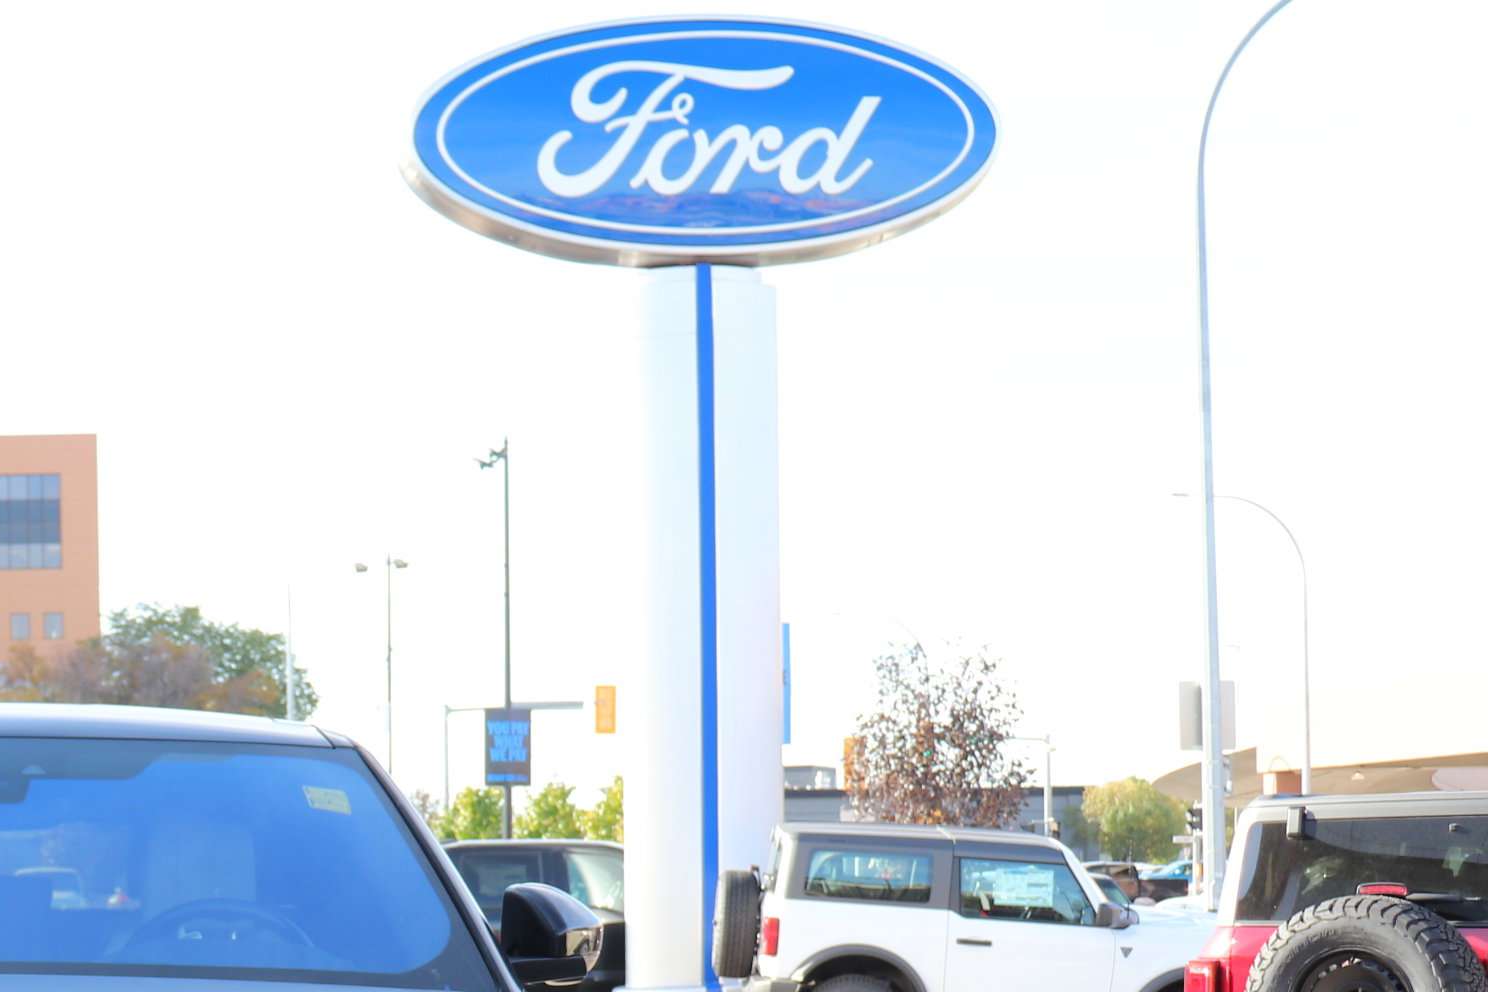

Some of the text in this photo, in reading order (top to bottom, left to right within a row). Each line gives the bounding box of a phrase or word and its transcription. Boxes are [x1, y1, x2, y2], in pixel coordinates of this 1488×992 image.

[537, 60, 882, 197] Ford
[487, 721, 529, 735] YOU PAY
[494, 735, 524, 748] WHAT
[490, 748, 526, 761] WE PAY
